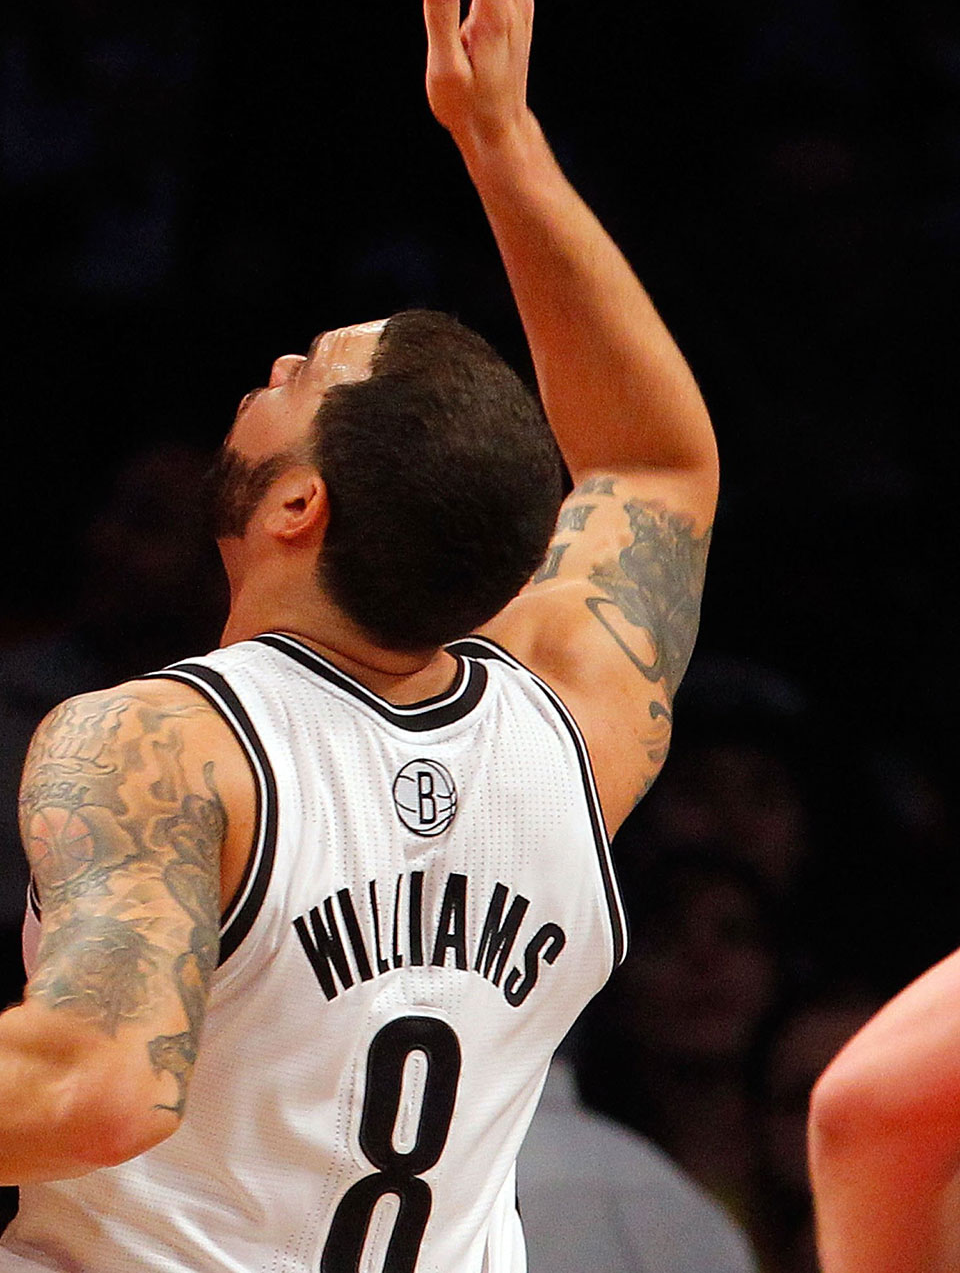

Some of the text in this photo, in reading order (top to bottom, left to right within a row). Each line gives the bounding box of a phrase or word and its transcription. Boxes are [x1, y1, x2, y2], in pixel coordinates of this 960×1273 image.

[417, 771, 436, 824] B
[293, 871, 566, 1008] WILLIAMS
[320, 1016, 461, 1273] 8
